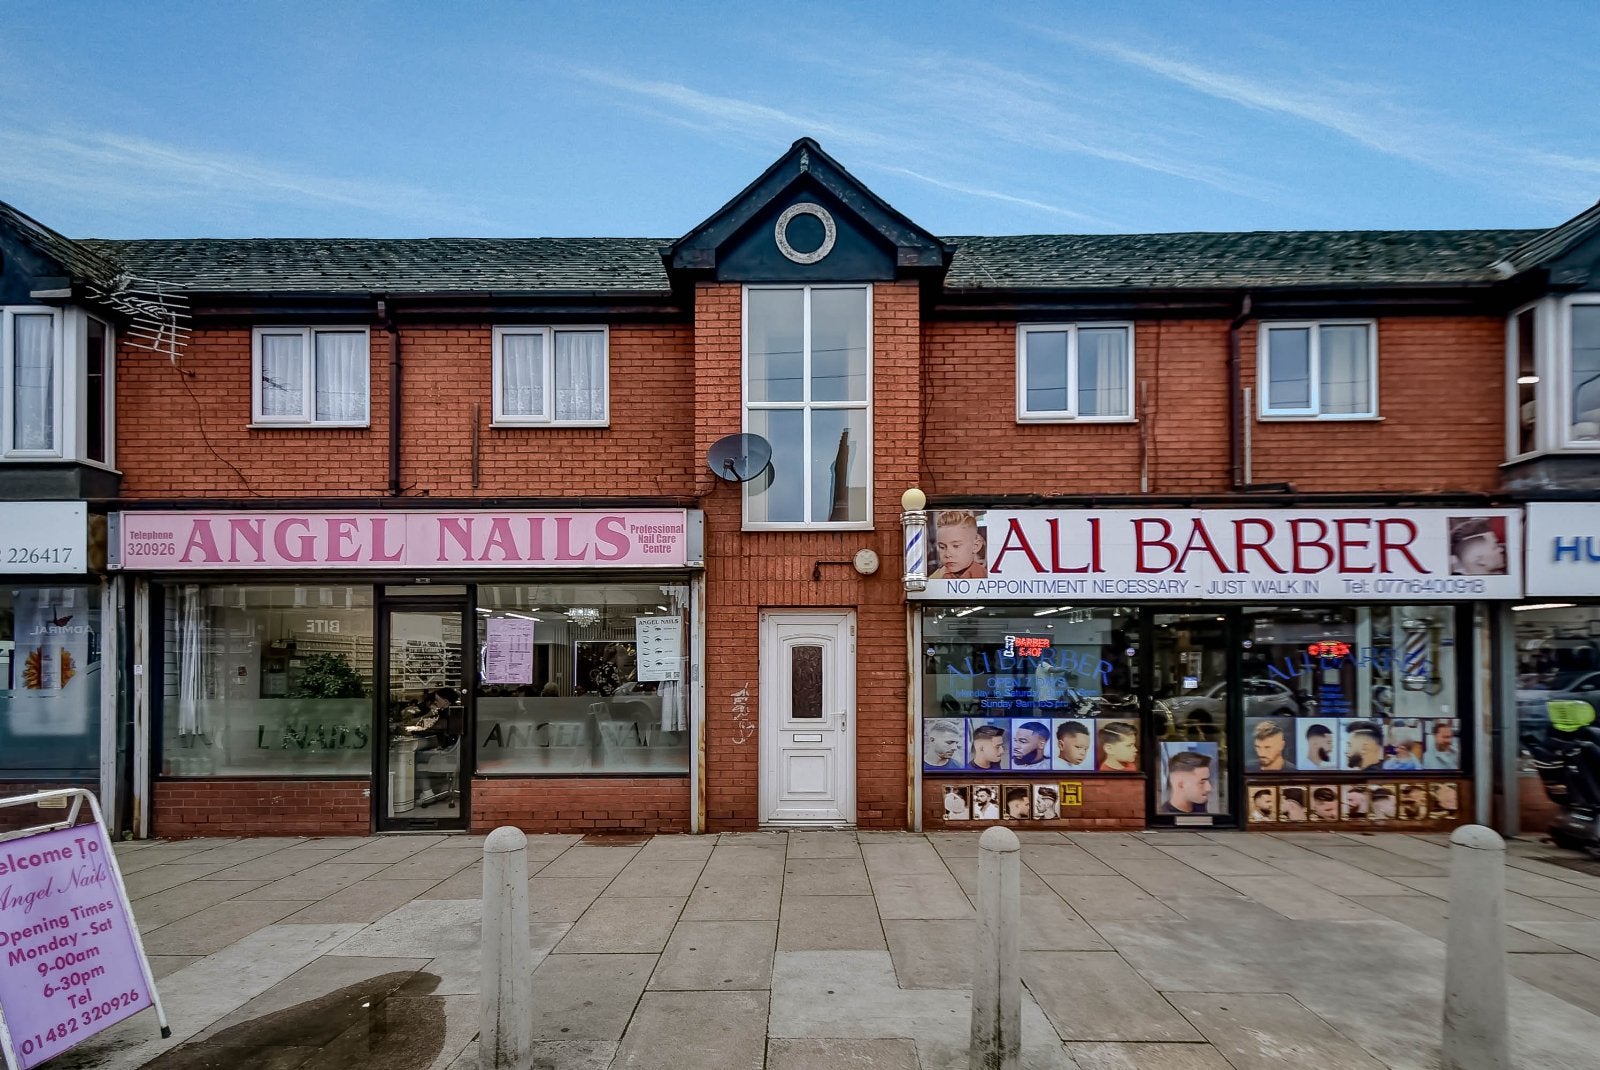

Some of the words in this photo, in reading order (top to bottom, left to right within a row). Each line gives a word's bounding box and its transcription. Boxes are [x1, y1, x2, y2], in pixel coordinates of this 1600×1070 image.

[129, 530, 174, 541] Telephone
[178, 517, 405, 563] ANGEL
[436, 515, 631, 562] NAILS
[630, 523, 684, 534] Professional
[638, 533, 655, 543] Nail
[656, 533, 677, 543] Care
[7, 547, 73, 564] 226417
[127, 542, 176, 556] 320926
[642, 543, 672, 554] Centre
[990, 517, 1106, 574] ALI
[1130, 516, 1433, 575] BARBER
[946, 579, 971, 594] NO
[976, 579, 1088, 594] APPOINTMENT
[1093, 579, 1190, 594] NECESSARY
[1207, 580, 1248, 595] JUST
[1251, 580, 1300, 594] WALK
[1303, 580, 1320, 594] IN
[1014, 637, 1051, 649] BARBER
[981, 699, 1012, 709] Sunday
[0, 847, 73, 876] elcome
[74, 837, 99, 860] To
[0, 876, 54, 914] Angel
[57, 863, 107, 894] Nails
[0, 915, 70, 948] Opening
[70, 900, 114, 921] Times
[8, 932, 78, 968] Monday
[89, 918, 113, 936] Sat
[37, 946, 100, 978] 9-00am
[43, 965, 105, 998] 6-30pm
[67, 987, 93, 1010] Tel
[21, 1017, 79, 1056] 01482
[81, 988, 139, 1026] 320926
